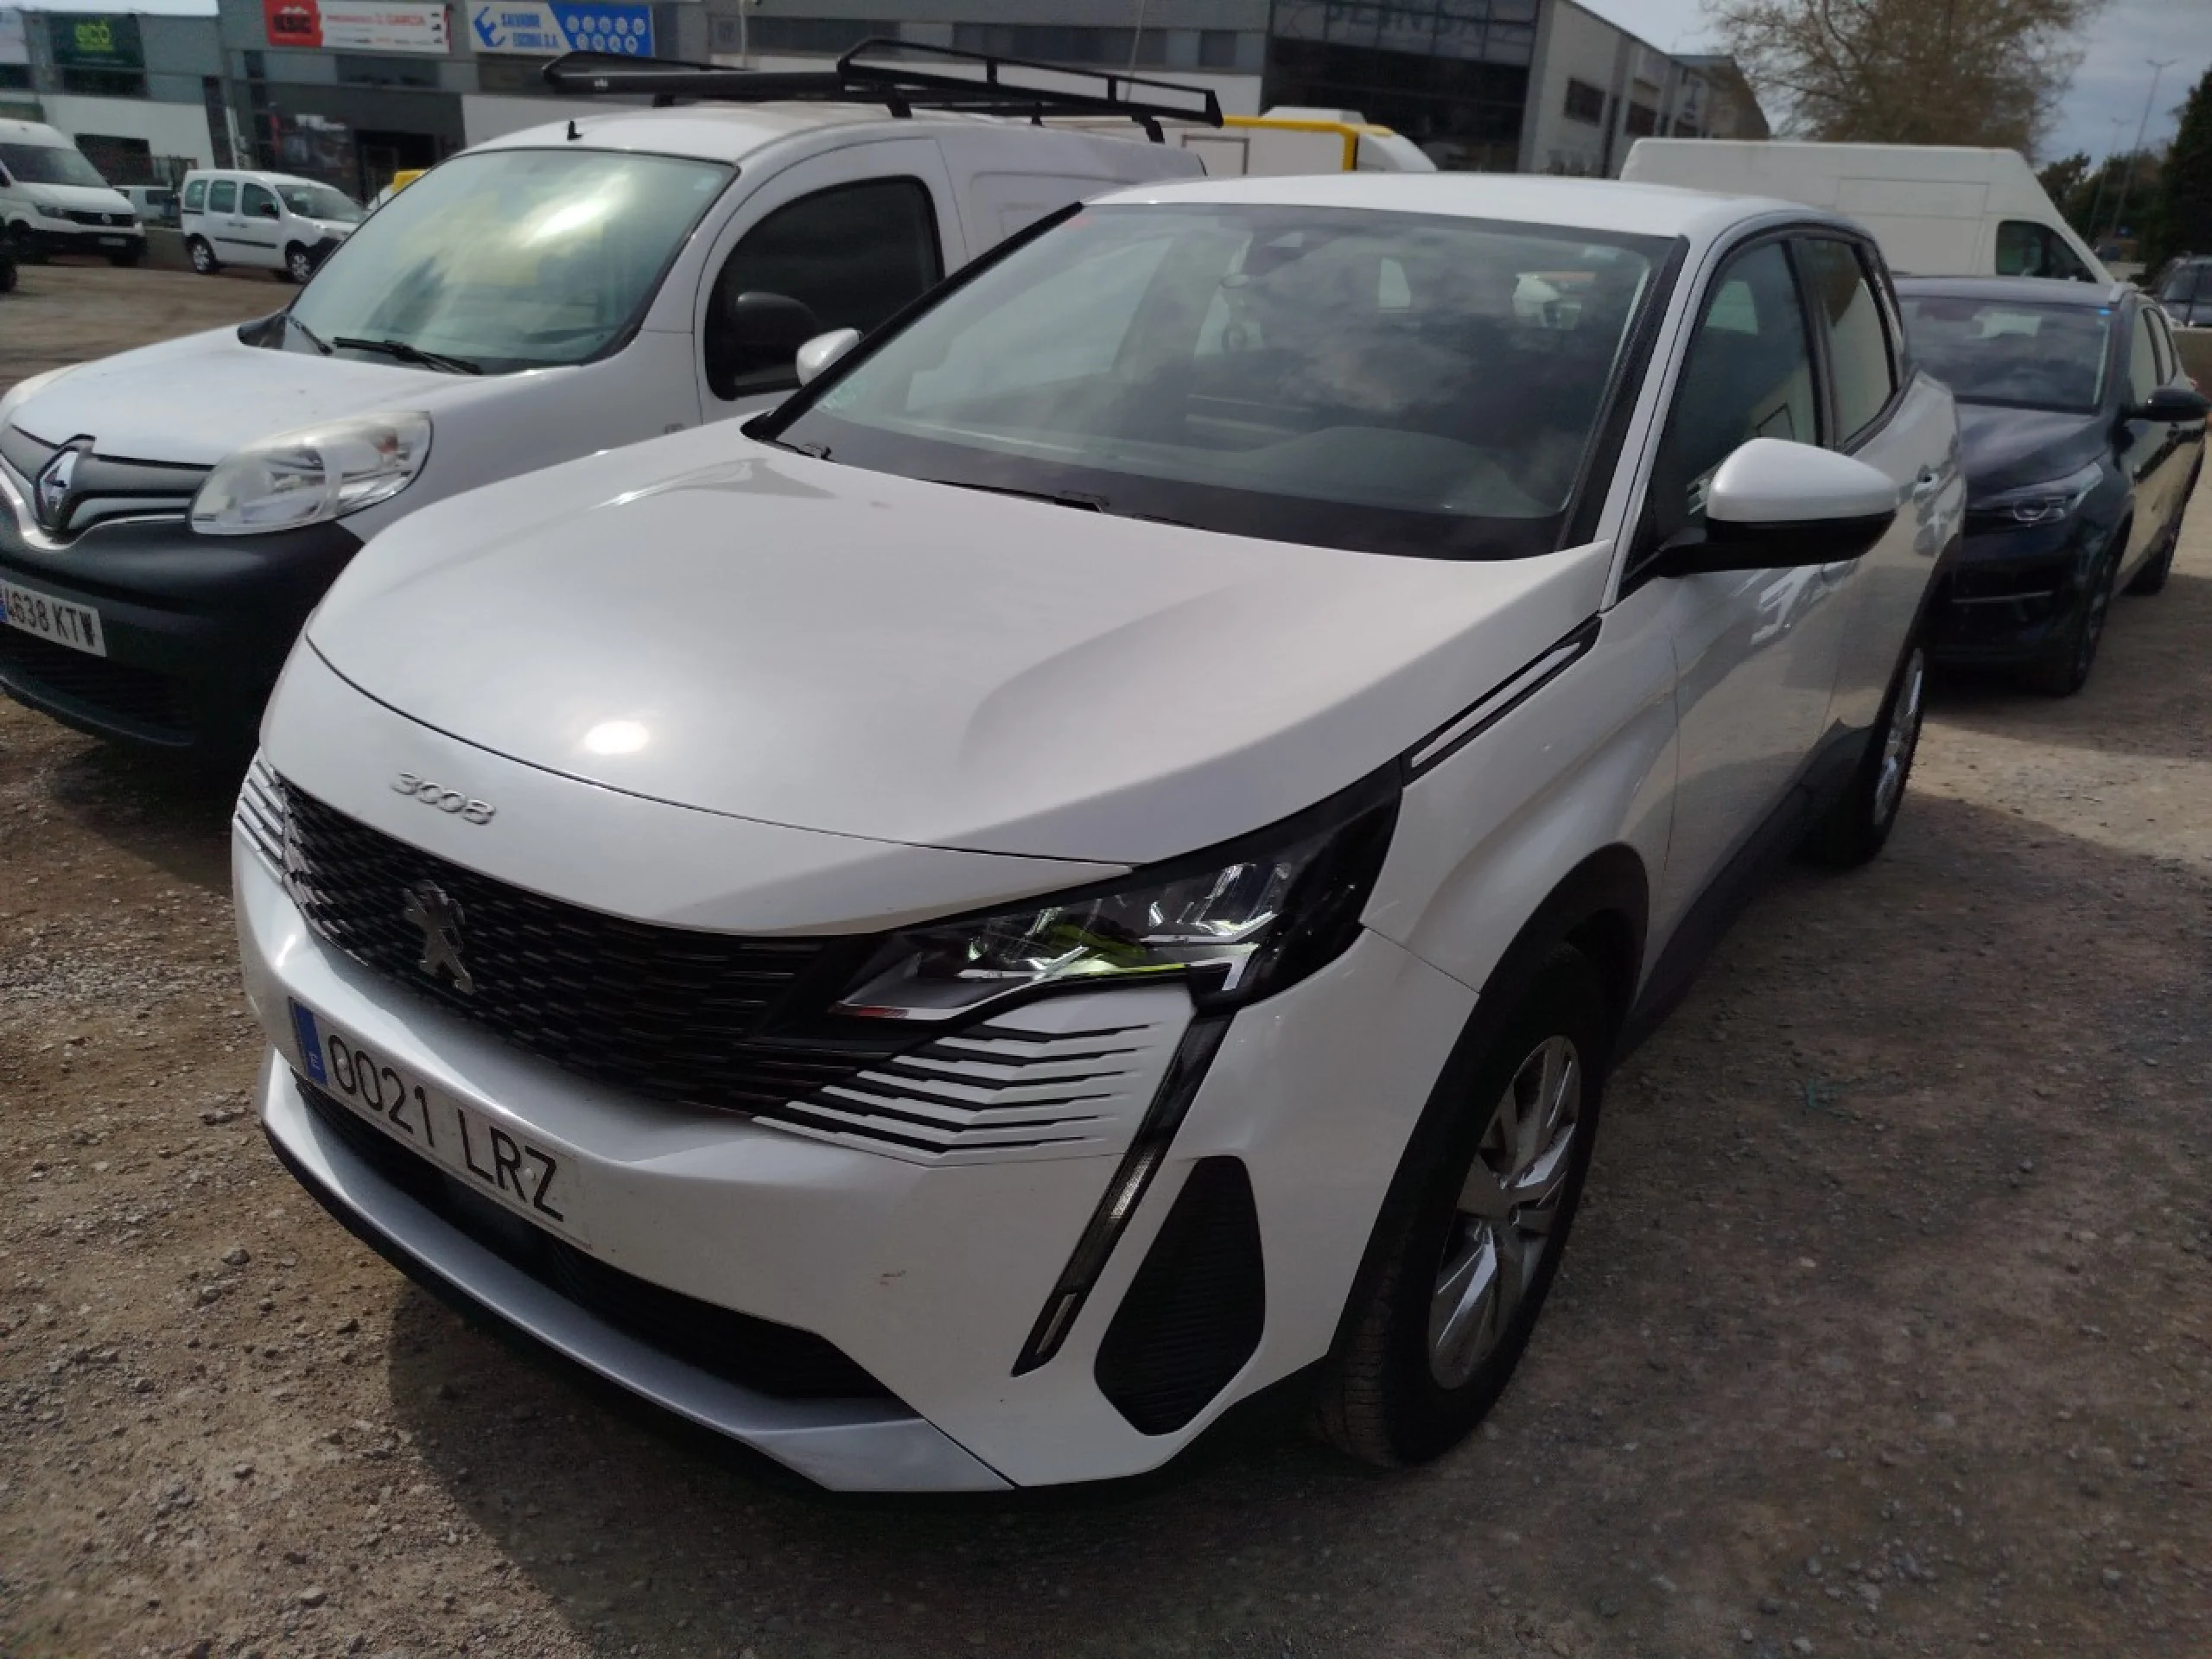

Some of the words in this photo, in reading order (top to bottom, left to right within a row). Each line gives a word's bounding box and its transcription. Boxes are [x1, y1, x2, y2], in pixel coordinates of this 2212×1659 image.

[51, 601, 96, 646] KTW
[391, 772, 497, 825] 3008
[328, 1034, 435, 1147] 0021
[457, 1108, 564, 1222] LRZ
